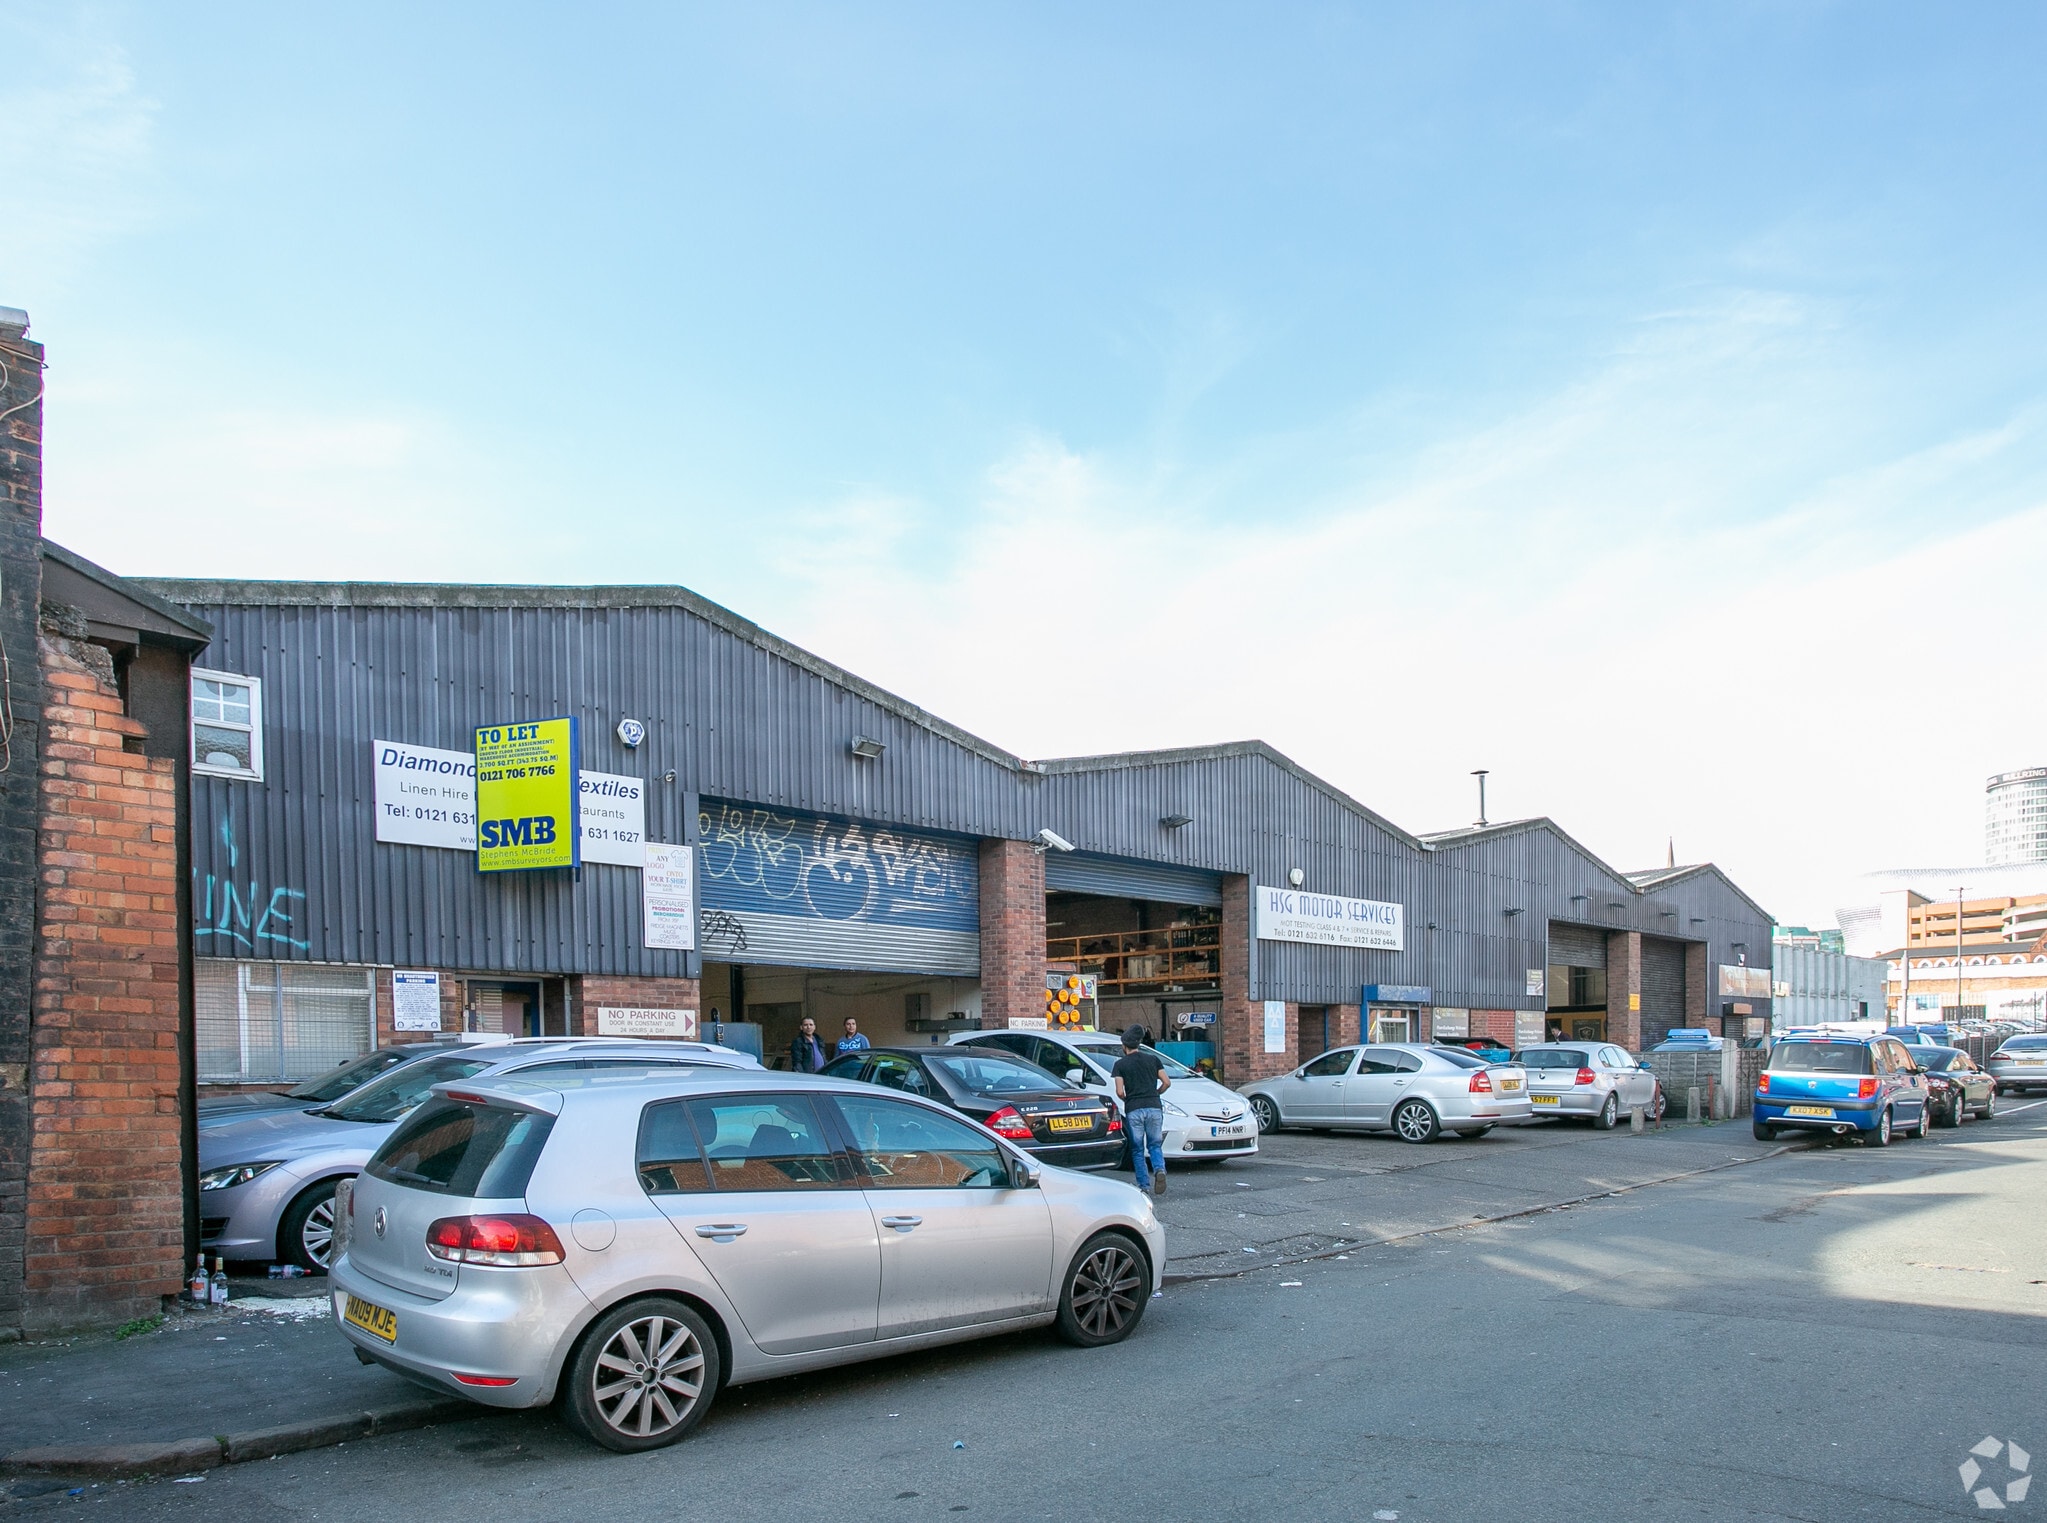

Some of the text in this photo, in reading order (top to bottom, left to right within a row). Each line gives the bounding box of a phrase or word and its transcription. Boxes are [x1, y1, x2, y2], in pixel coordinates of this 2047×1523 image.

[479, 725, 539, 745] TO LET
[480, 765, 556, 782] 0121 706 7766
[400, 782, 469, 800] Linen Hire
[579, 777, 640, 800] extiles
[384, 803, 476, 825] Tel: 0121 631
[481, 815, 556, 849] SMB
[588, 827, 640, 843] 631 1627
[481, 847, 556, 860] Stephens McBride
[1271, 892, 1396, 925] HSG MOTOR SERVICES
[1274, 928, 1286, 937] Tel:
[1288, 930, 1304, 938] 0121
[1319, 933, 1335, 941] 6116
[1354, 936, 1369, 944] 0121
[1294, 920, 1316, 929] TESTING
[1317, 923, 1332, 931] CLASS
[1350, 927, 1370, 935] SERVICE
[1375, 929, 1392, 937] REPAIRS
[608, 1010, 676, 1020] NO PARKING
[1021, 1020, 1046, 1028] PARKING
[1052, 1117, 1089, 1128] LL58 DYH
[1218, 1126, 1231, 1134] PF14
[348, 1295, 396, 1334] NA09 MJE
